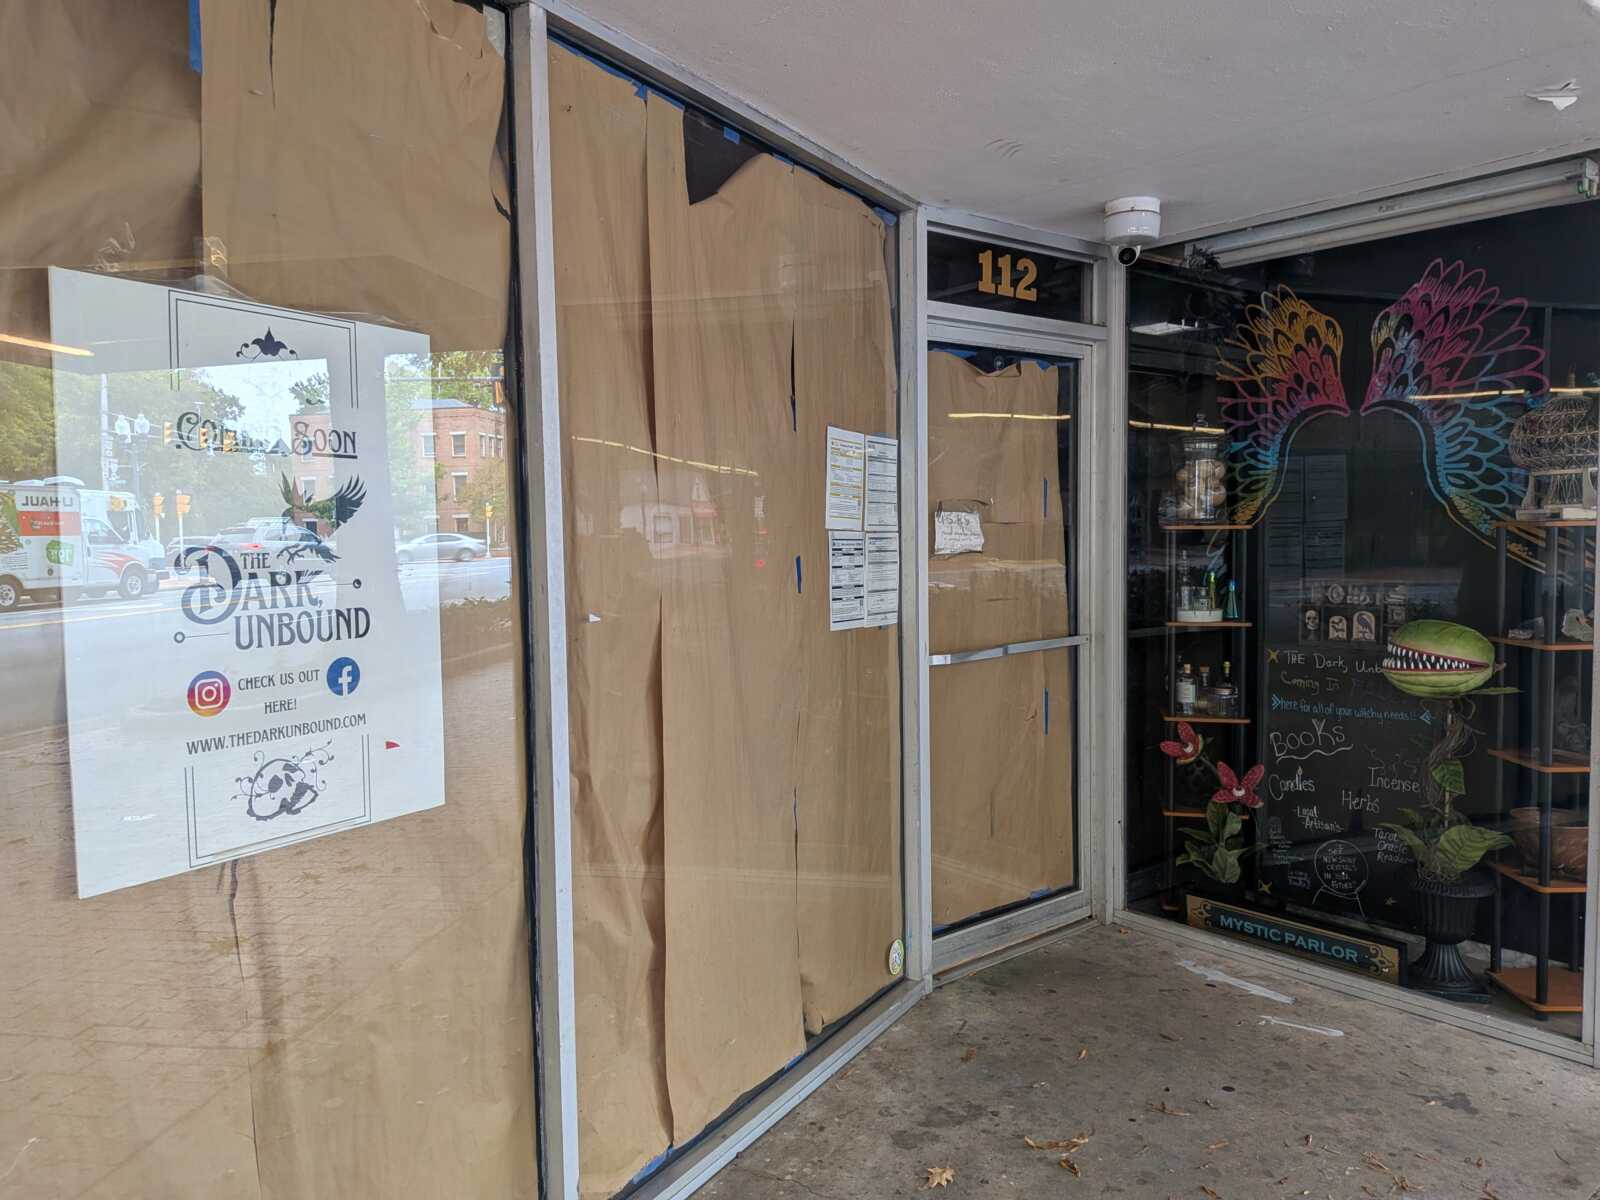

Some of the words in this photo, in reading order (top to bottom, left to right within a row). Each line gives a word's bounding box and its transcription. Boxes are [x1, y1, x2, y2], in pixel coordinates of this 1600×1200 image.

[978, 250, 1038, 302] 112
[240, 552, 271, 570] THE
[234, 607, 371, 650] UNBOUND
[238, 672, 276, 691] CHECK
[280, 671, 295, 686] US
[299, 669, 321, 683] OUT
[264, 698, 298, 715] HERE!
[186, 712, 367, 756] WWW.THEDARKUNBOUND.COM
[1268, 773, 1316, 801] Candles
[1368, 766, 1421, 793] Incense
[1342, 789, 1380, 814] Herbs
[1219, 914, 1282, 943] MYSTIC
[1284, 932, 1359, 964] PARLOR
